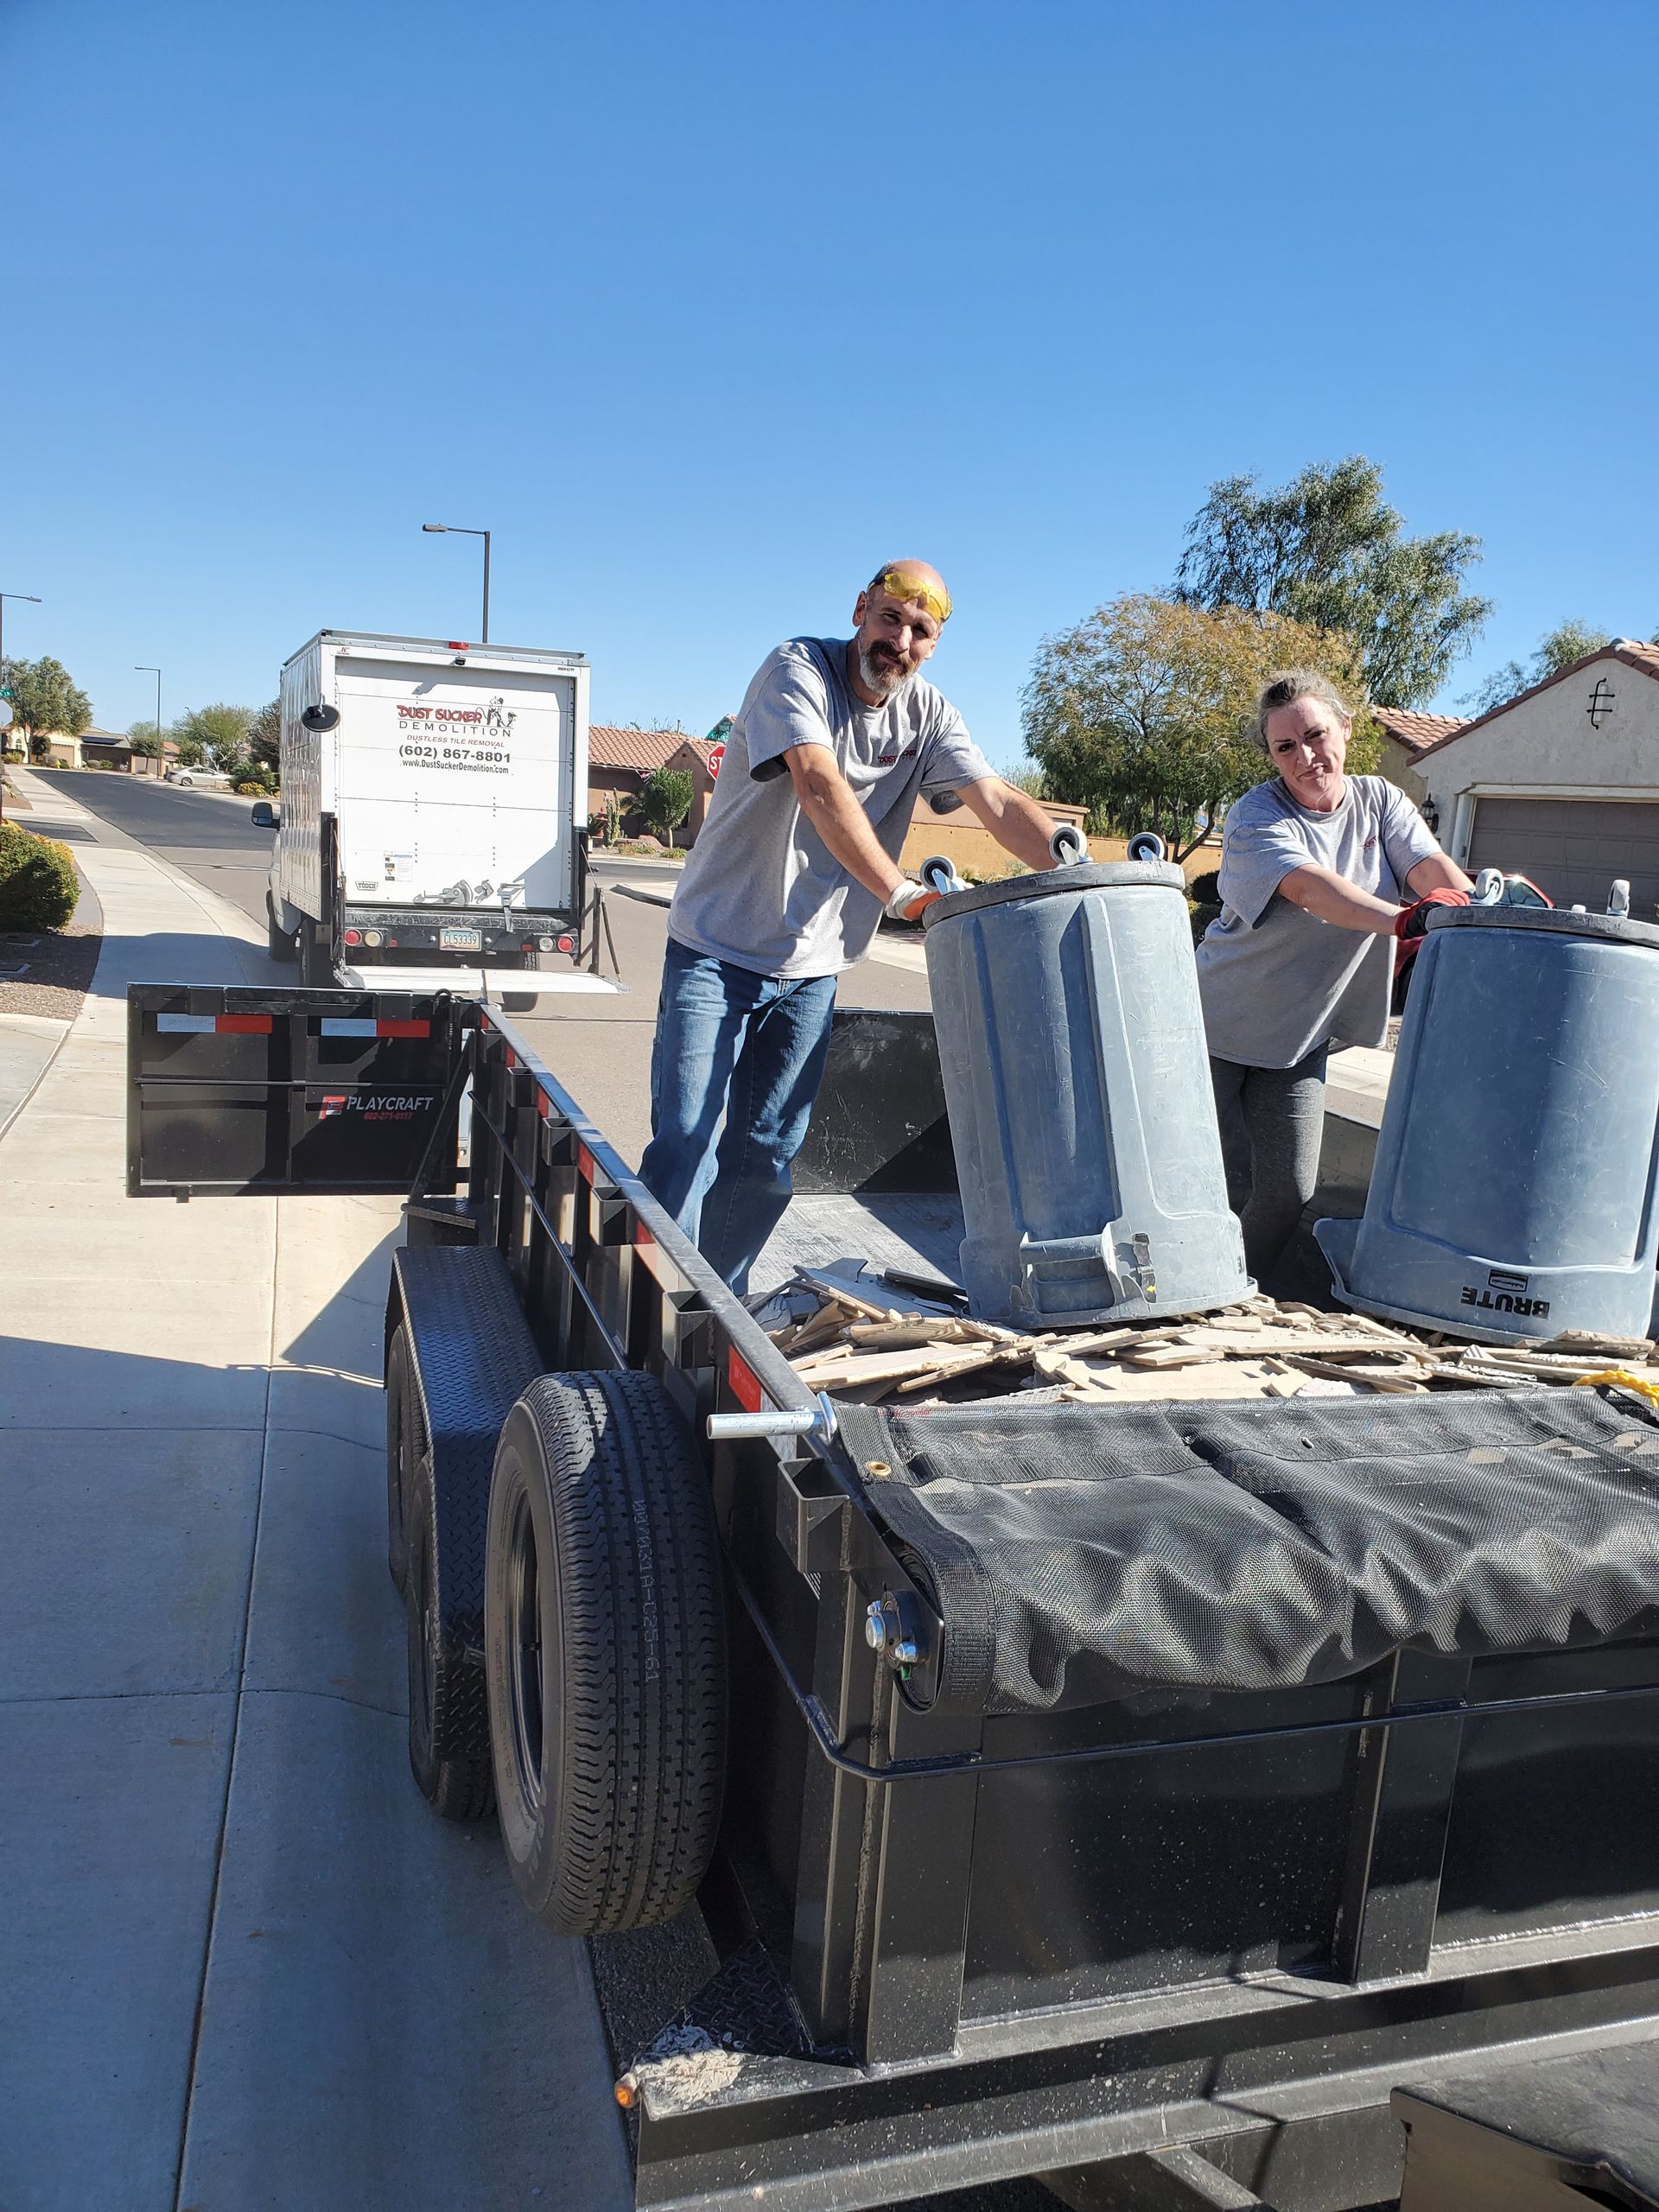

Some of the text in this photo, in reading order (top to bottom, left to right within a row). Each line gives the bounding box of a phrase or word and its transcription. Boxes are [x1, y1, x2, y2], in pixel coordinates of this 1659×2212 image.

[397, 705, 483, 723] DUST SUCKER
[399, 721, 511, 737] DEMOLITION
[407, 734, 448, 743] DUSTLESS
[468, 739, 505, 747] REMOVAL
[398, 745, 511, 763] (602) 867-8801
[403, 759, 509, 774] www.DustSuckerDemolition.com
[709, 756, 723, 770] ST
[346, 1096, 434, 1110] PLAYCRAFT
[1460, 1287, 1550, 1319] BRUTE
